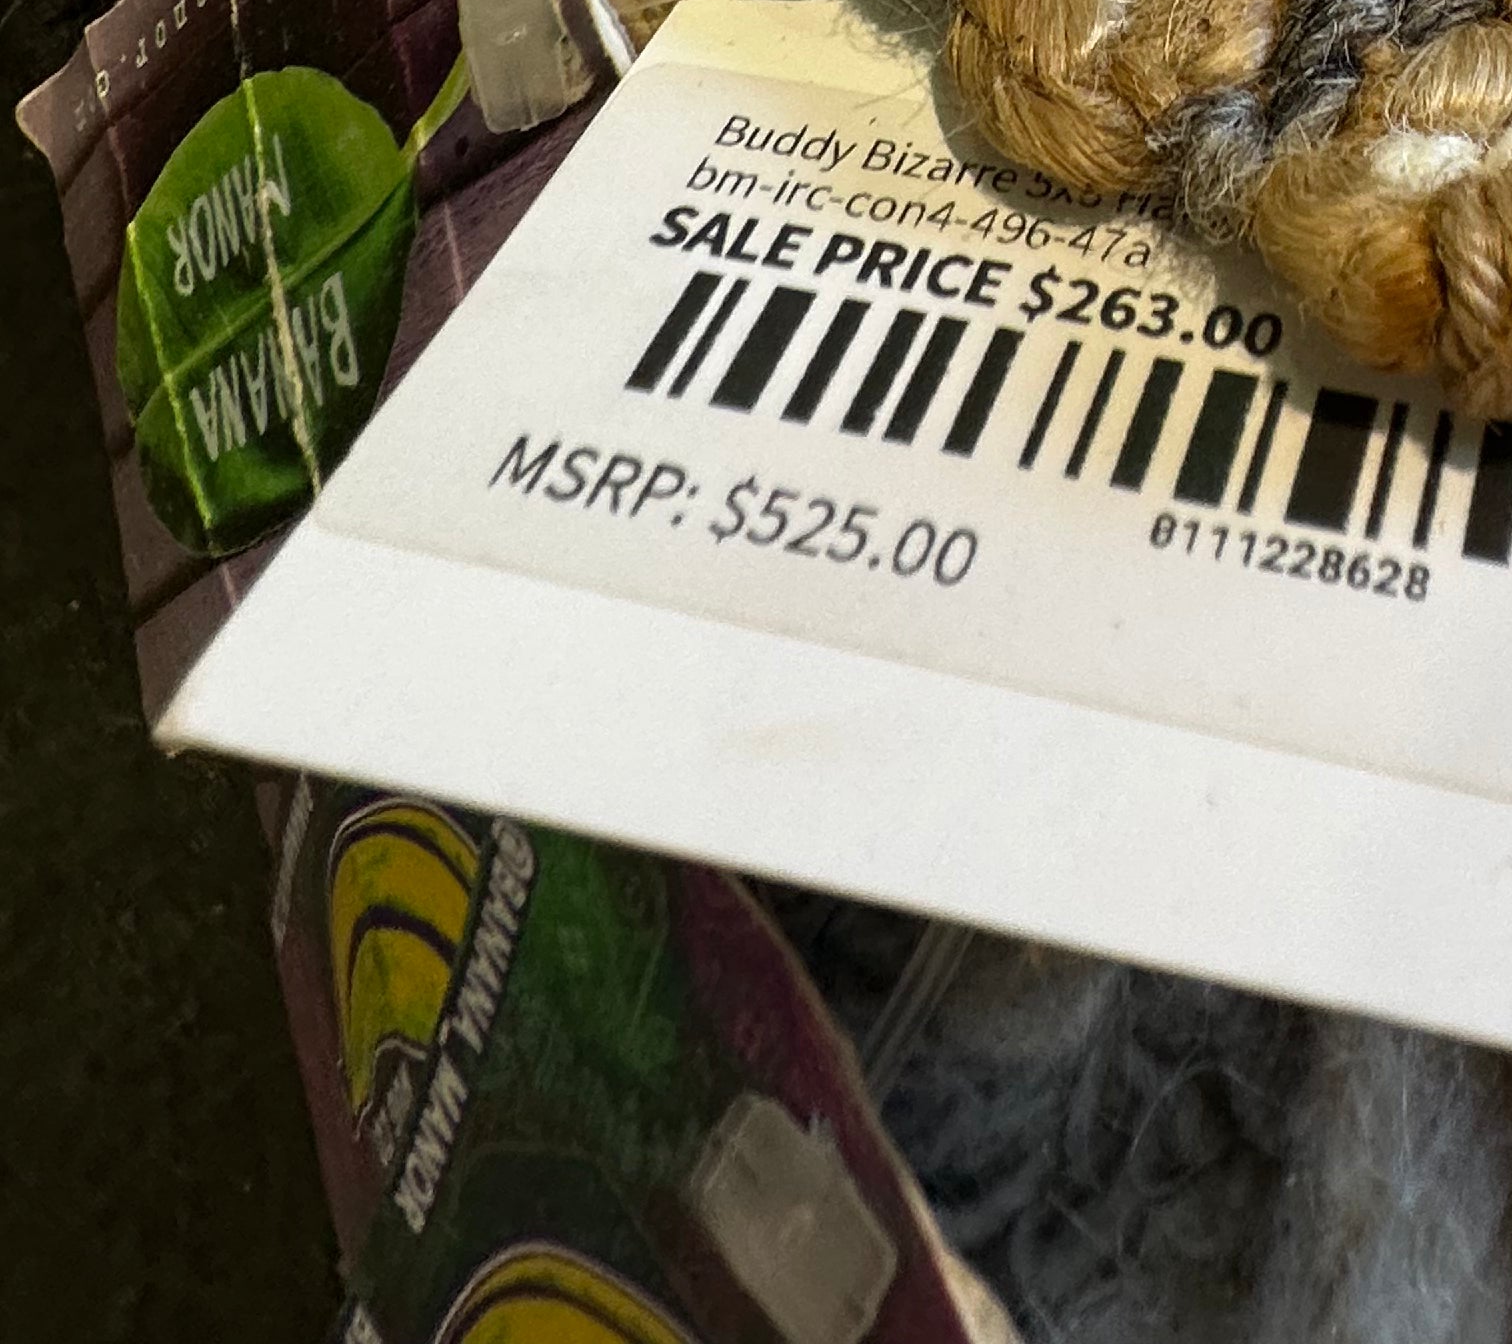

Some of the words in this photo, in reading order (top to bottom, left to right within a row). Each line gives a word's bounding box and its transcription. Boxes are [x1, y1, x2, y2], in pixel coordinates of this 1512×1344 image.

[173, 135, 292, 295] MANOR
[686, 154, 1150, 267] bm-irc-con4-496-47a
[714, 114, 857, 172] Buddy
[861, 139, 1017, 192] Bizarre
[649, 205, 814, 270] SALE
[813, 233, 1012, 308] PRICE
[1019, 264, 1284, 358] $263.00
[189, 271, 360, 462] BANANA
[487, 432, 700, 527] MSRP:
[709, 475, 979, 586] $525.00
